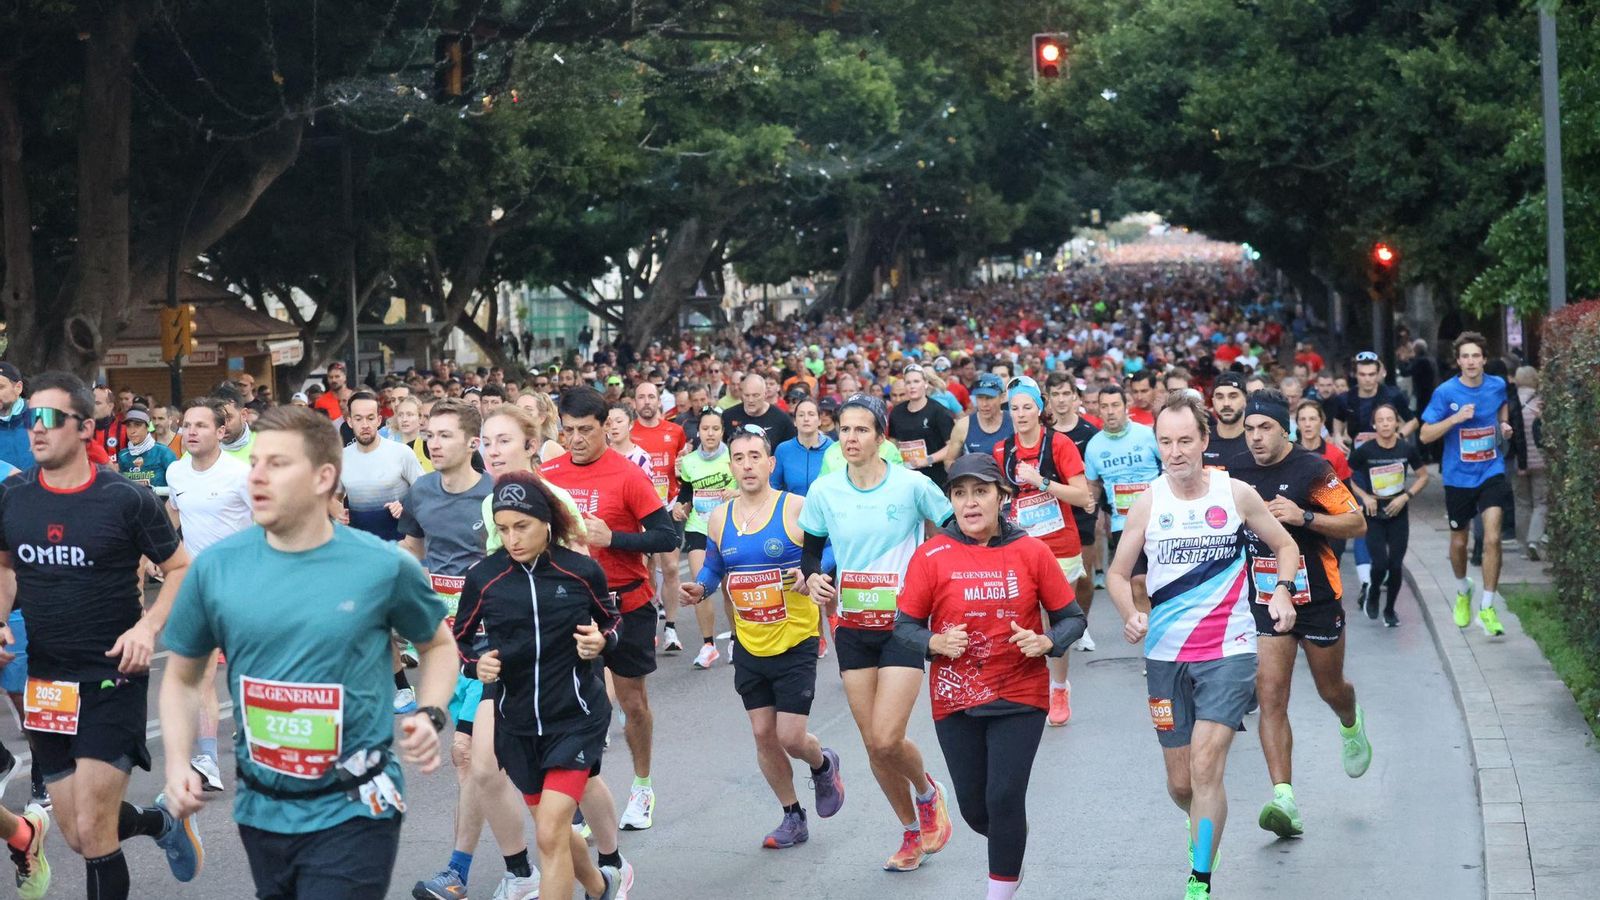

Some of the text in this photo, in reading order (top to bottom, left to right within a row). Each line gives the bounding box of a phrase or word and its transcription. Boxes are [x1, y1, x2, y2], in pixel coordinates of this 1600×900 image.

[1103, 451, 1143, 468] nerja
[1172, 537, 1199, 551] MEDIA
[740, 571, 777, 584] GENERALI
[855, 574, 896, 584] GENERALI
[963, 570, 1003, 579] GENERALI
[442, 578, 466, 589] GENER
[742, 590, 768, 602] 3131
[858, 591, 879, 604] 820
[964, 585, 1006, 601] MÁLAGA
[35, 685, 62, 702] 2052
[264, 686, 334, 705] GENERALI
[265, 715, 313, 737] 2753
